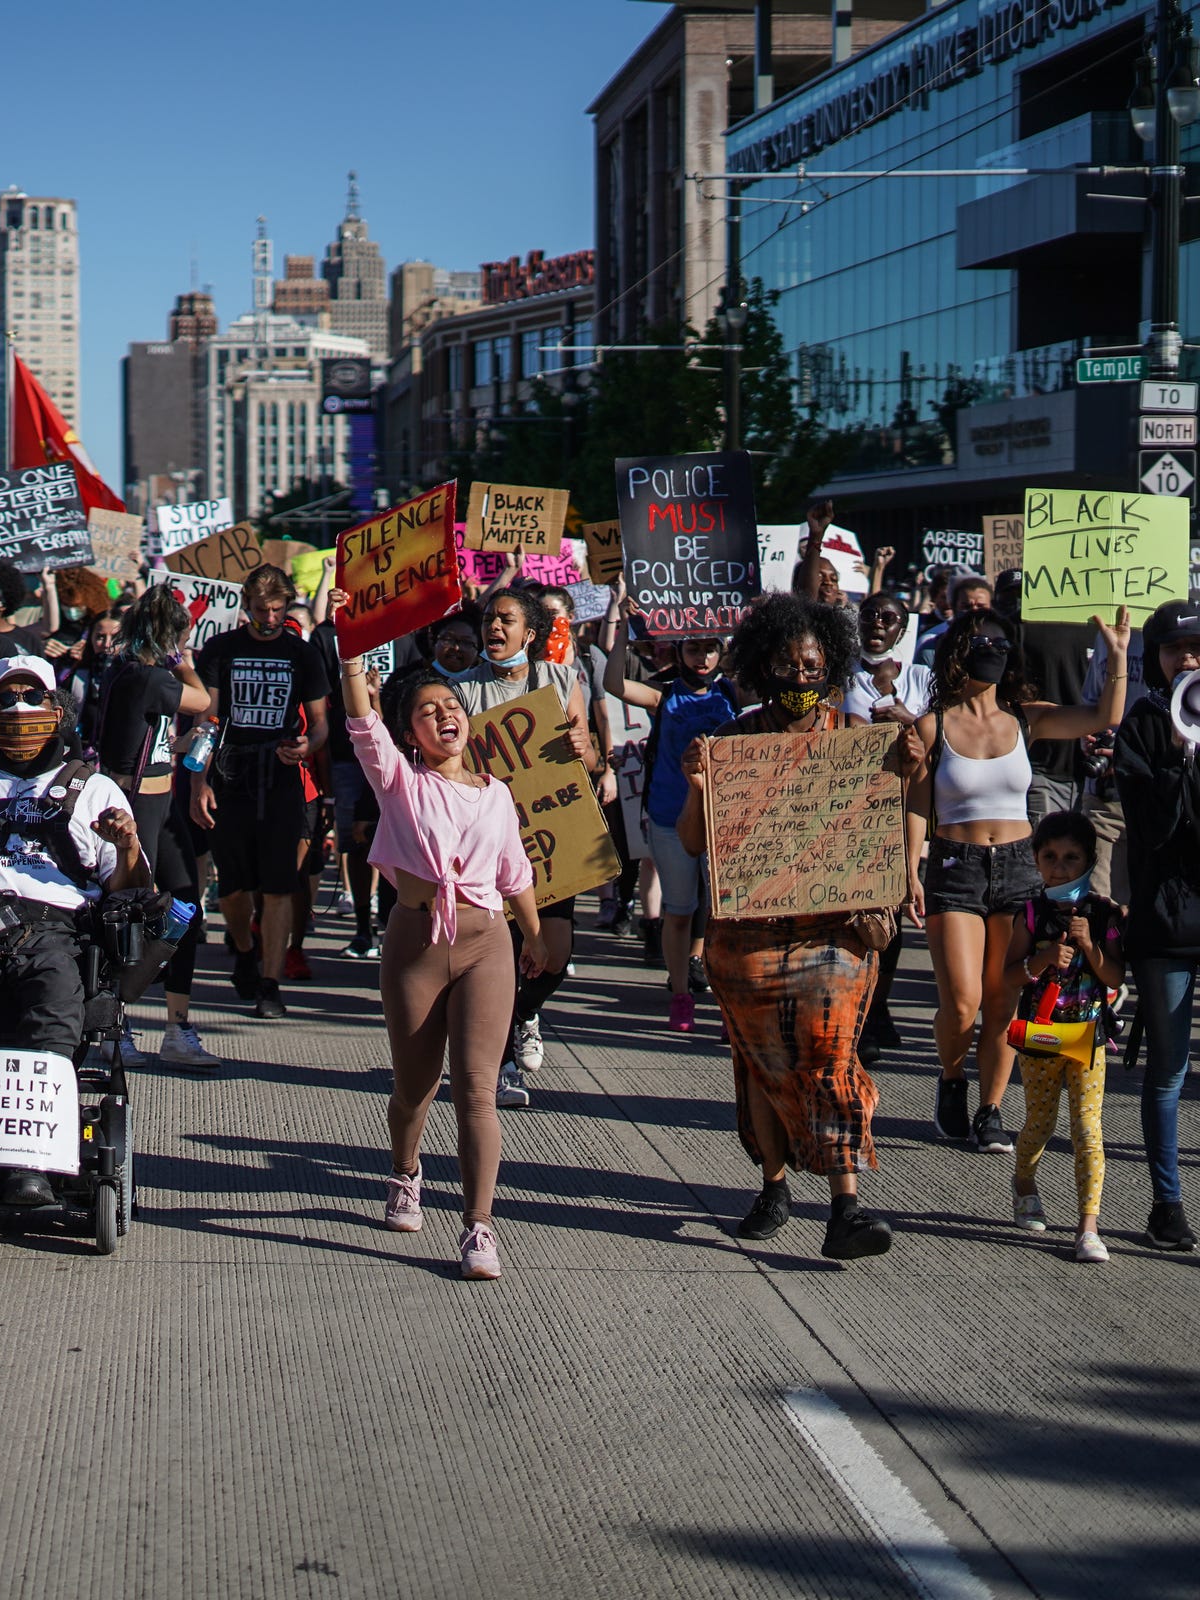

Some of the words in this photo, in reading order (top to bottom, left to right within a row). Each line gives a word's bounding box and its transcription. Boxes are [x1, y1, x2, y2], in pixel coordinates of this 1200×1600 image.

[813, 66, 903, 147] UNIVERSITY
[924, 27, 972, 93] MIKE
[1085, 359, 1142, 379] Temple
[1158, 388, 1180, 404] TO
[1144, 422, 1193, 439] NORTH
[1161, 461, 1174, 470] M
[14, 483, 72, 503] FREE
[629, 465, 729, 499] POLICE
[1156, 472, 1180, 493] 10
[171, 500, 220, 524] STOP
[494, 493, 544, 511] BLACK
[1027, 492, 1150, 528] BLACK
[490, 511, 539, 529] LIVES
[648, 502, 727, 532] MUST
[992, 519, 1024, 539] END
[342, 494, 443, 565] SILENCE
[485, 527, 546, 545] MATTER
[922, 530, 984, 549] ARREST
[179, 527, 263, 580] ACAB
[674, 535, 710, 560] BE
[922, 547, 984, 565] VIOLENT
[1069, 533, 1138, 560] LIVES
[374, 545, 395, 576] IS
[342, 549, 449, 620] VIOLENCE
[631, 560, 754, 587] POLICED!
[1024, 565, 1175, 599] MATTER
[189, 581, 239, 610] STAND
[638, 590, 683, 605] OWN
[689, 591, 713, 605] UP
[717, 591, 743, 605] TO
[639, 606, 704, 630] YOUR
[233, 682, 289, 707] LIVES
[232, 706, 284, 727] MATTER
[867, 755, 884, 768] Fo
[828, 773, 882, 794] people
[531, 796, 557, 814] OR
[555, 783, 583, 807] BE
[716, 808, 730, 818] or
[829, 799, 853, 812] For
[863, 794, 901, 811] Some
[862, 812, 902, 830] are
[845, 847, 874, 859] are
[735, 884, 798, 913] Barack
